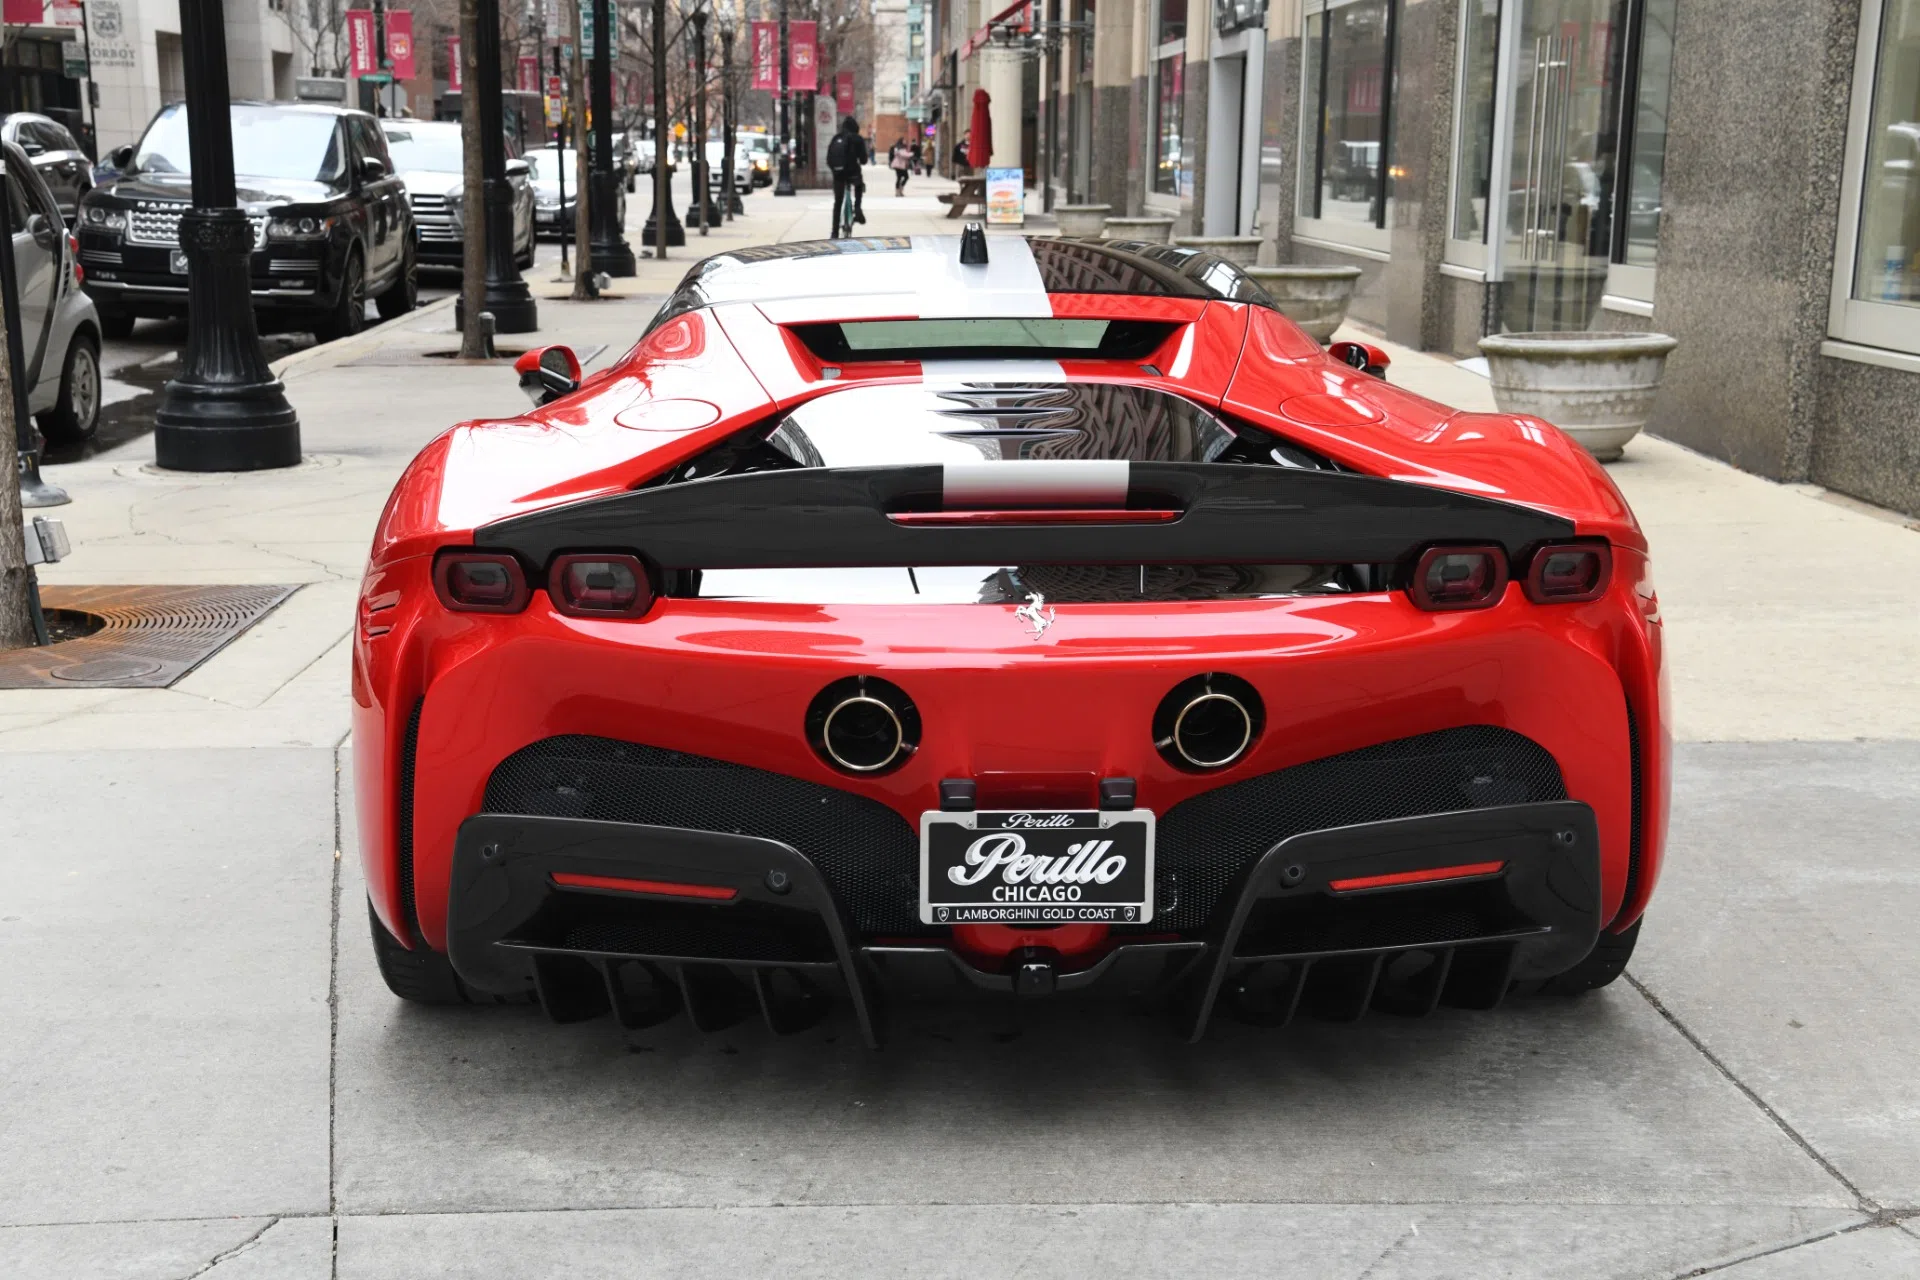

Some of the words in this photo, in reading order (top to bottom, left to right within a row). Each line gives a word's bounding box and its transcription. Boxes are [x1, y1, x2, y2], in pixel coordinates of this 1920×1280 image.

[354, 18, 366, 71] WELCOME
[1001, 813, 1075, 828] Perillo
[948, 832, 1127, 886] Perillo
[992, 886, 1082, 902] CHICAGO
[956, 908, 1039, 920] LAMBORGHINI
[1042, 908, 1075, 919] GOLD
[1078, 908, 1117, 919] COAST
